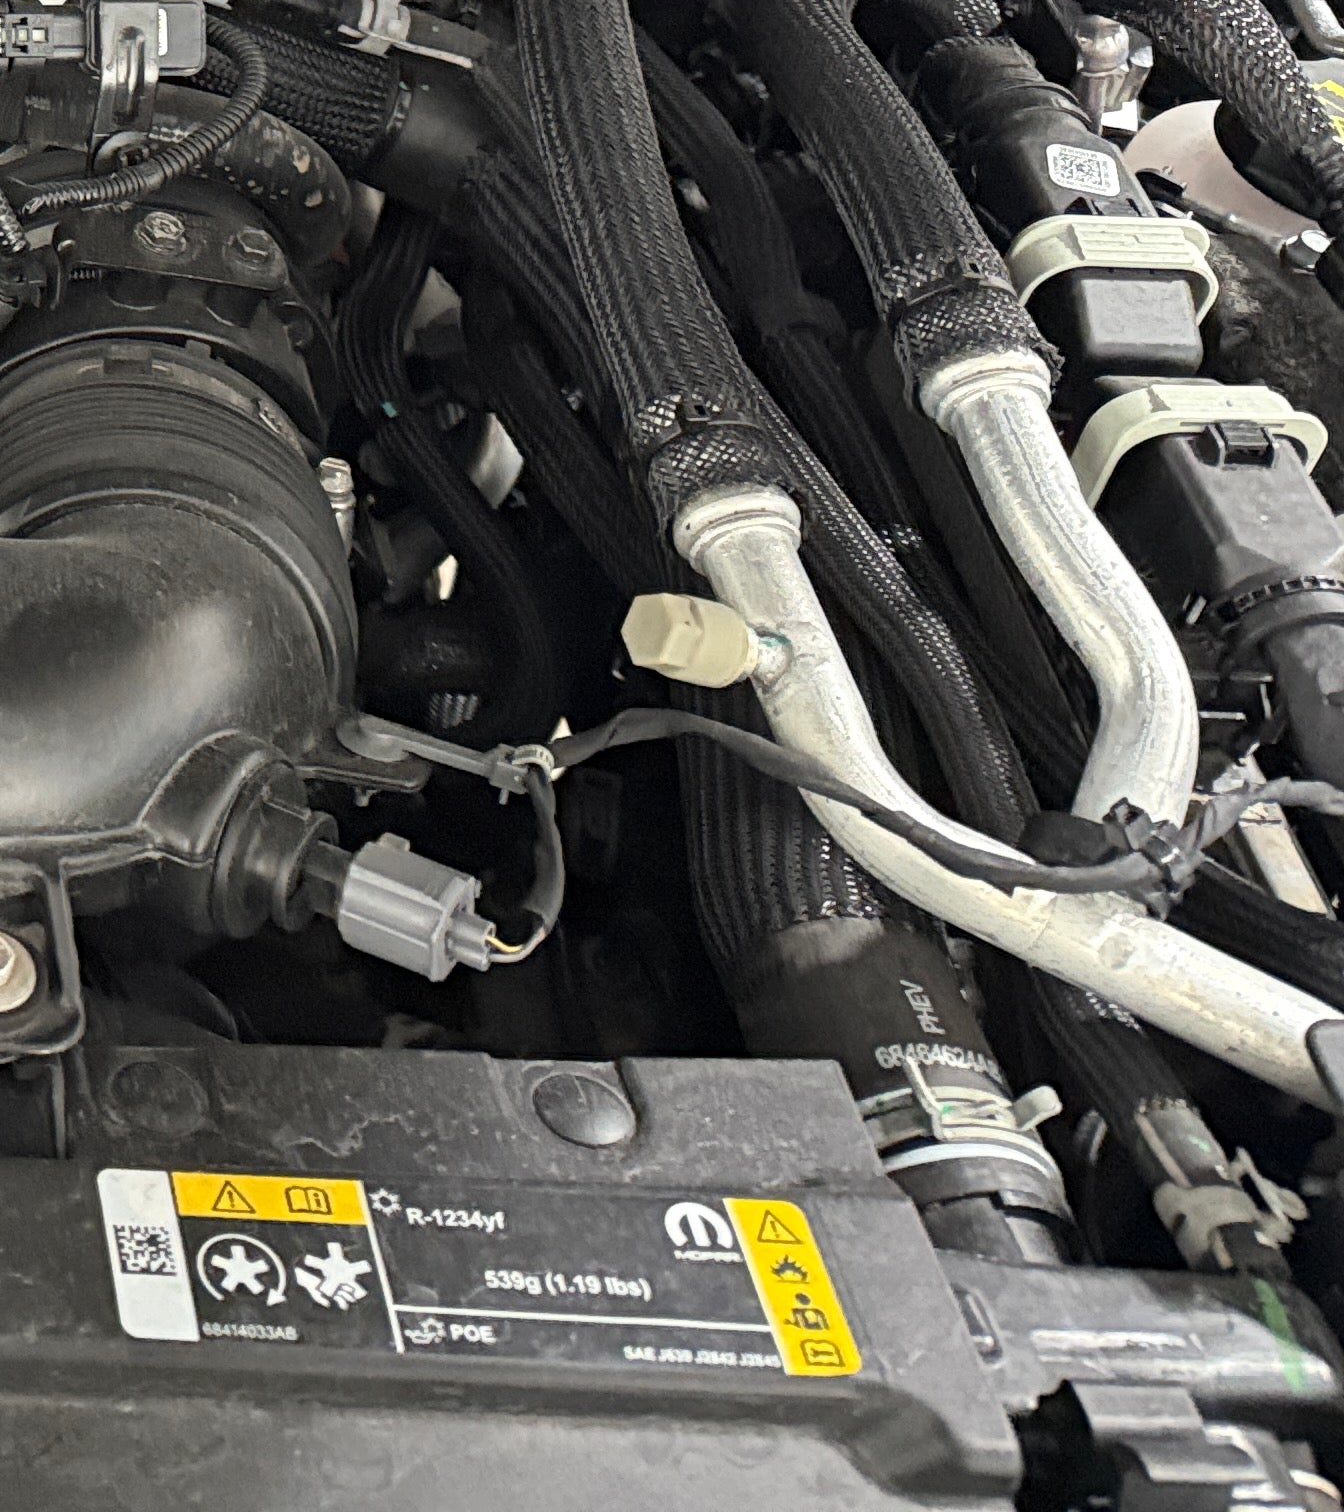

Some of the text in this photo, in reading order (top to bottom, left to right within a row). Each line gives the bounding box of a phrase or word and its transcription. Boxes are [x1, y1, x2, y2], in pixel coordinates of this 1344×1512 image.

[898, 978, 948, 1036] PHEV
[405, 1206, 507, 1233] R-1234yf
[484, 1269, 652, 1302] 539g (1.19 lbs)
[450, 1324, 496, 1344] POE
[623, 1345, 657, 1362] SAE
